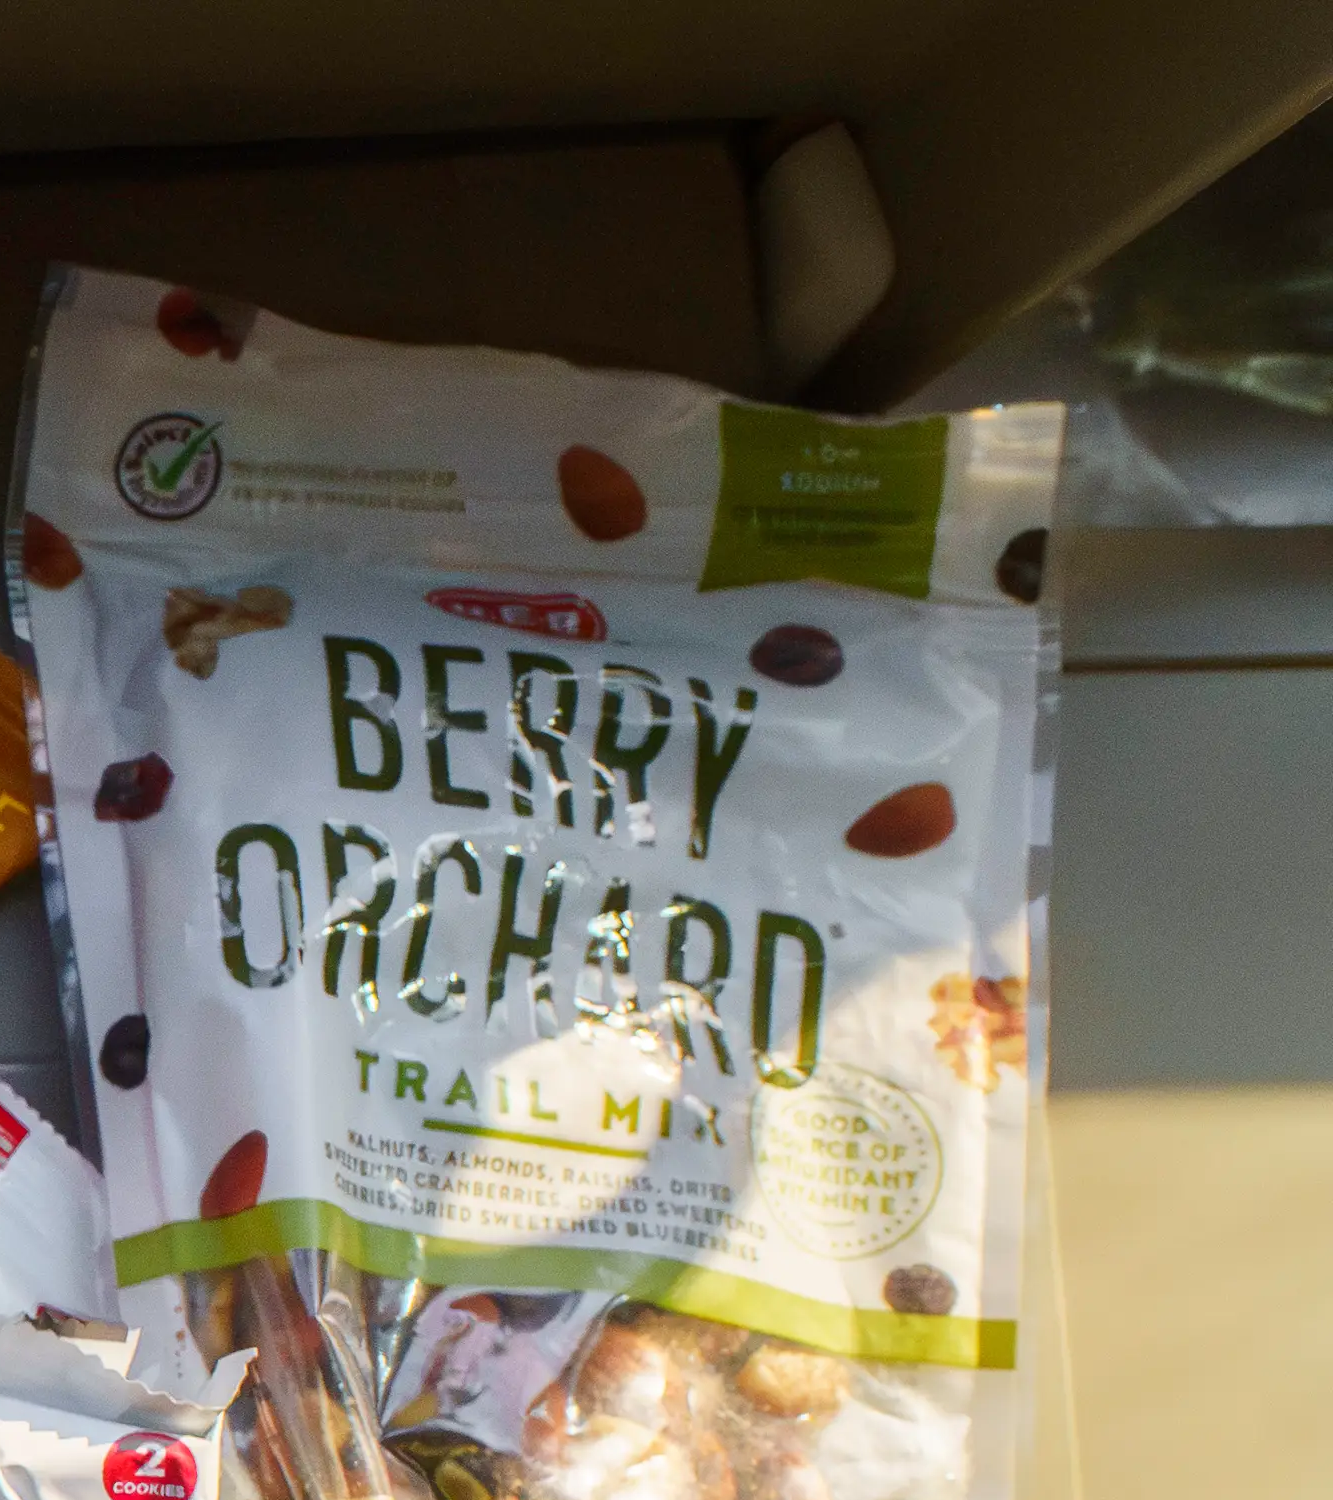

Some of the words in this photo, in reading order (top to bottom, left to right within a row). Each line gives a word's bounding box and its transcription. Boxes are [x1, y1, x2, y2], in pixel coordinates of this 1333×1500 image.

[321, 634, 759, 861] BERRY
[213, 820, 828, 1090] ORCHARD
[354, 1049, 559, 1123] TRAIL
[792, 1110, 869, 1135] GOOD
[444, 1151, 554, 1184] ALMONDS,
[869, 1142, 907, 1163] OF
[411, 1200, 472, 1222] DRIED
[133, 1440, 167, 1479] 2
[112, 1479, 187, 1500] COOKIES
